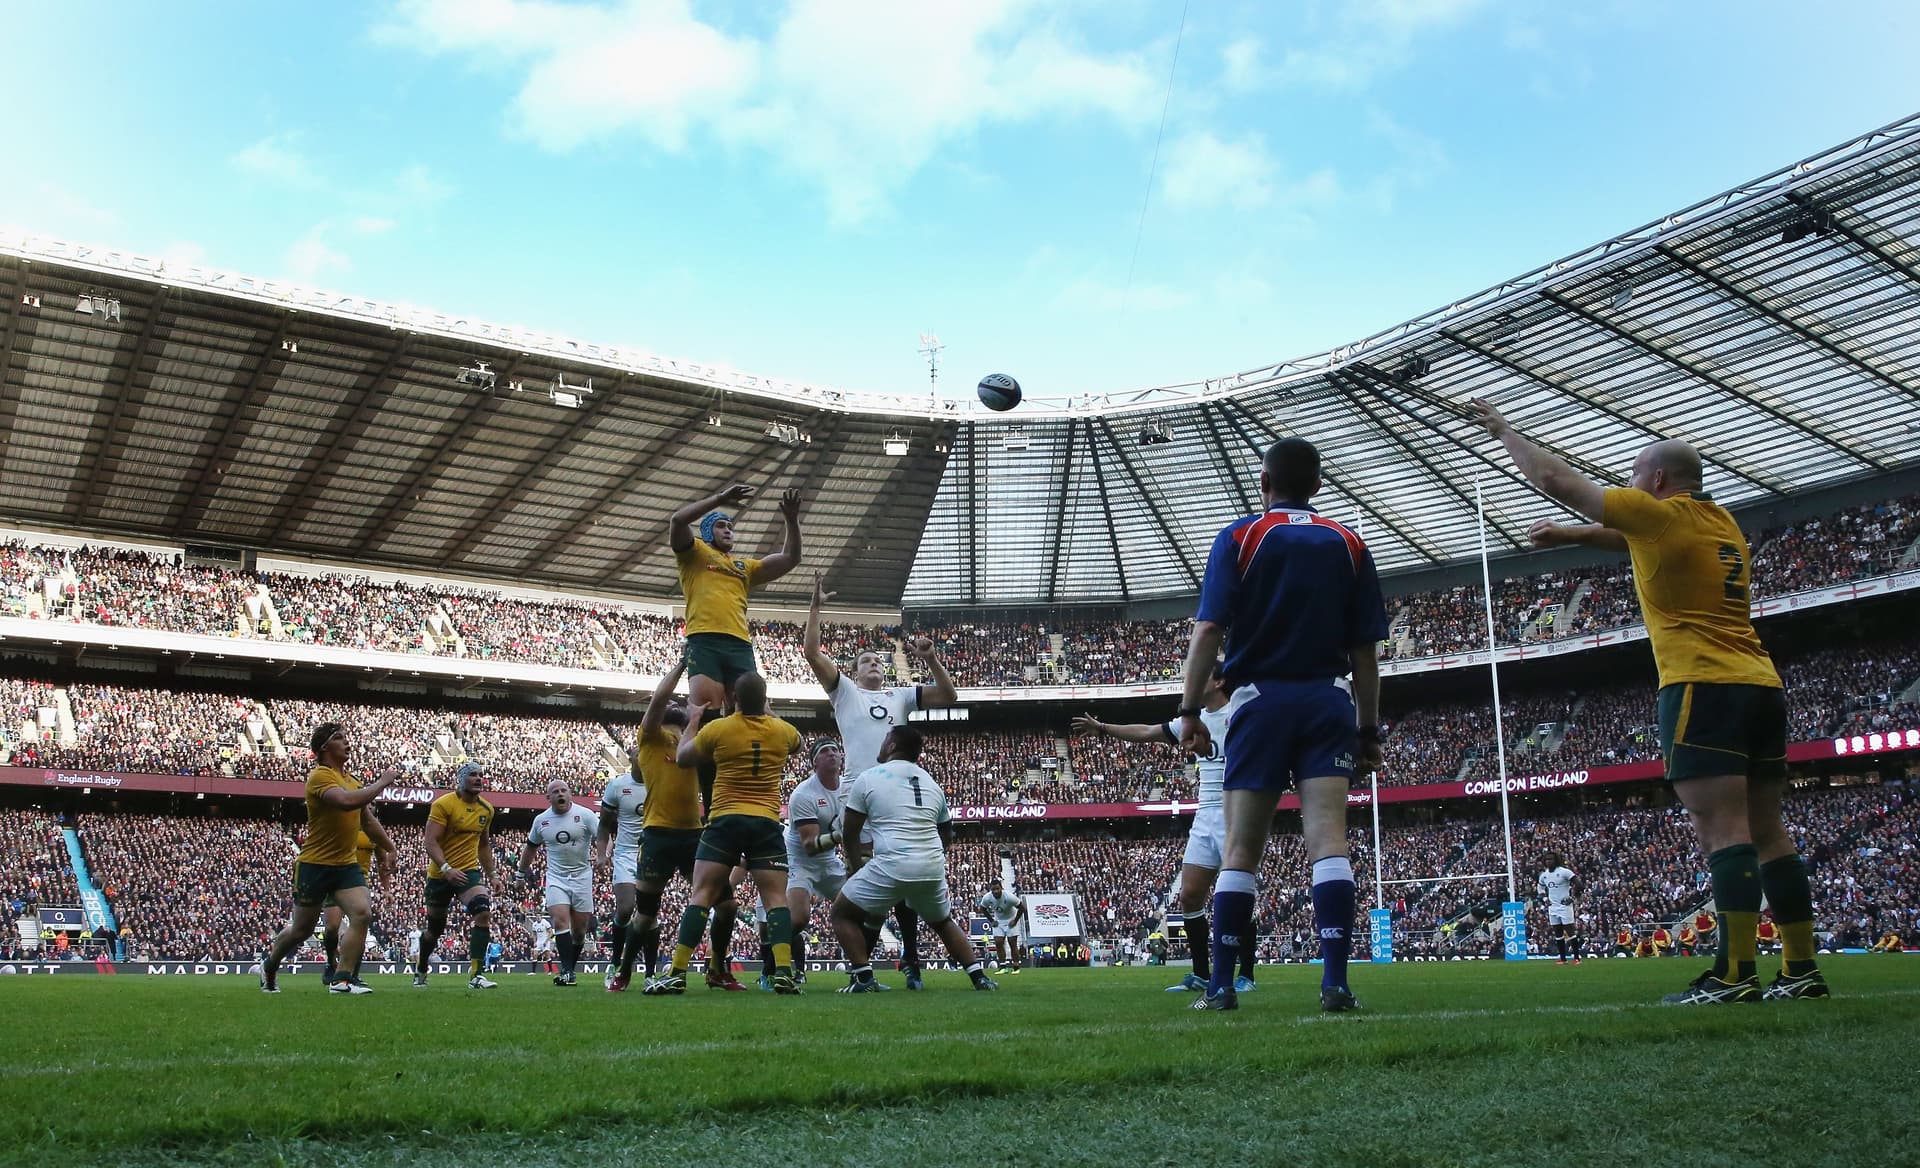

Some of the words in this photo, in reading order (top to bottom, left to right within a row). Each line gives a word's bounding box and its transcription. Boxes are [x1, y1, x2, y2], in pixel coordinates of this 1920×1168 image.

[1718, 544, 1744, 599] 2
[752, 742, 761, 777] 1
[58, 774, 93, 784] England
[95, 776, 122, 786] Rugby
[909, 775, 922, 807] 1
[1465, 780, 1501, 795] COME
[1507, 777, 1526, 791] ON
[1530, 771, 1588, 789] ENGLAND
[375, 788, 434, 802] NGLAND
[1347, 793, 1371, 802] Rugby
[967, 807, 984, 818] ON
[988, 806, 1046, 818] ENGLAND
[1370, 915, 1381, 944] QBE
[1503, 909, 1517, 939] QBE
